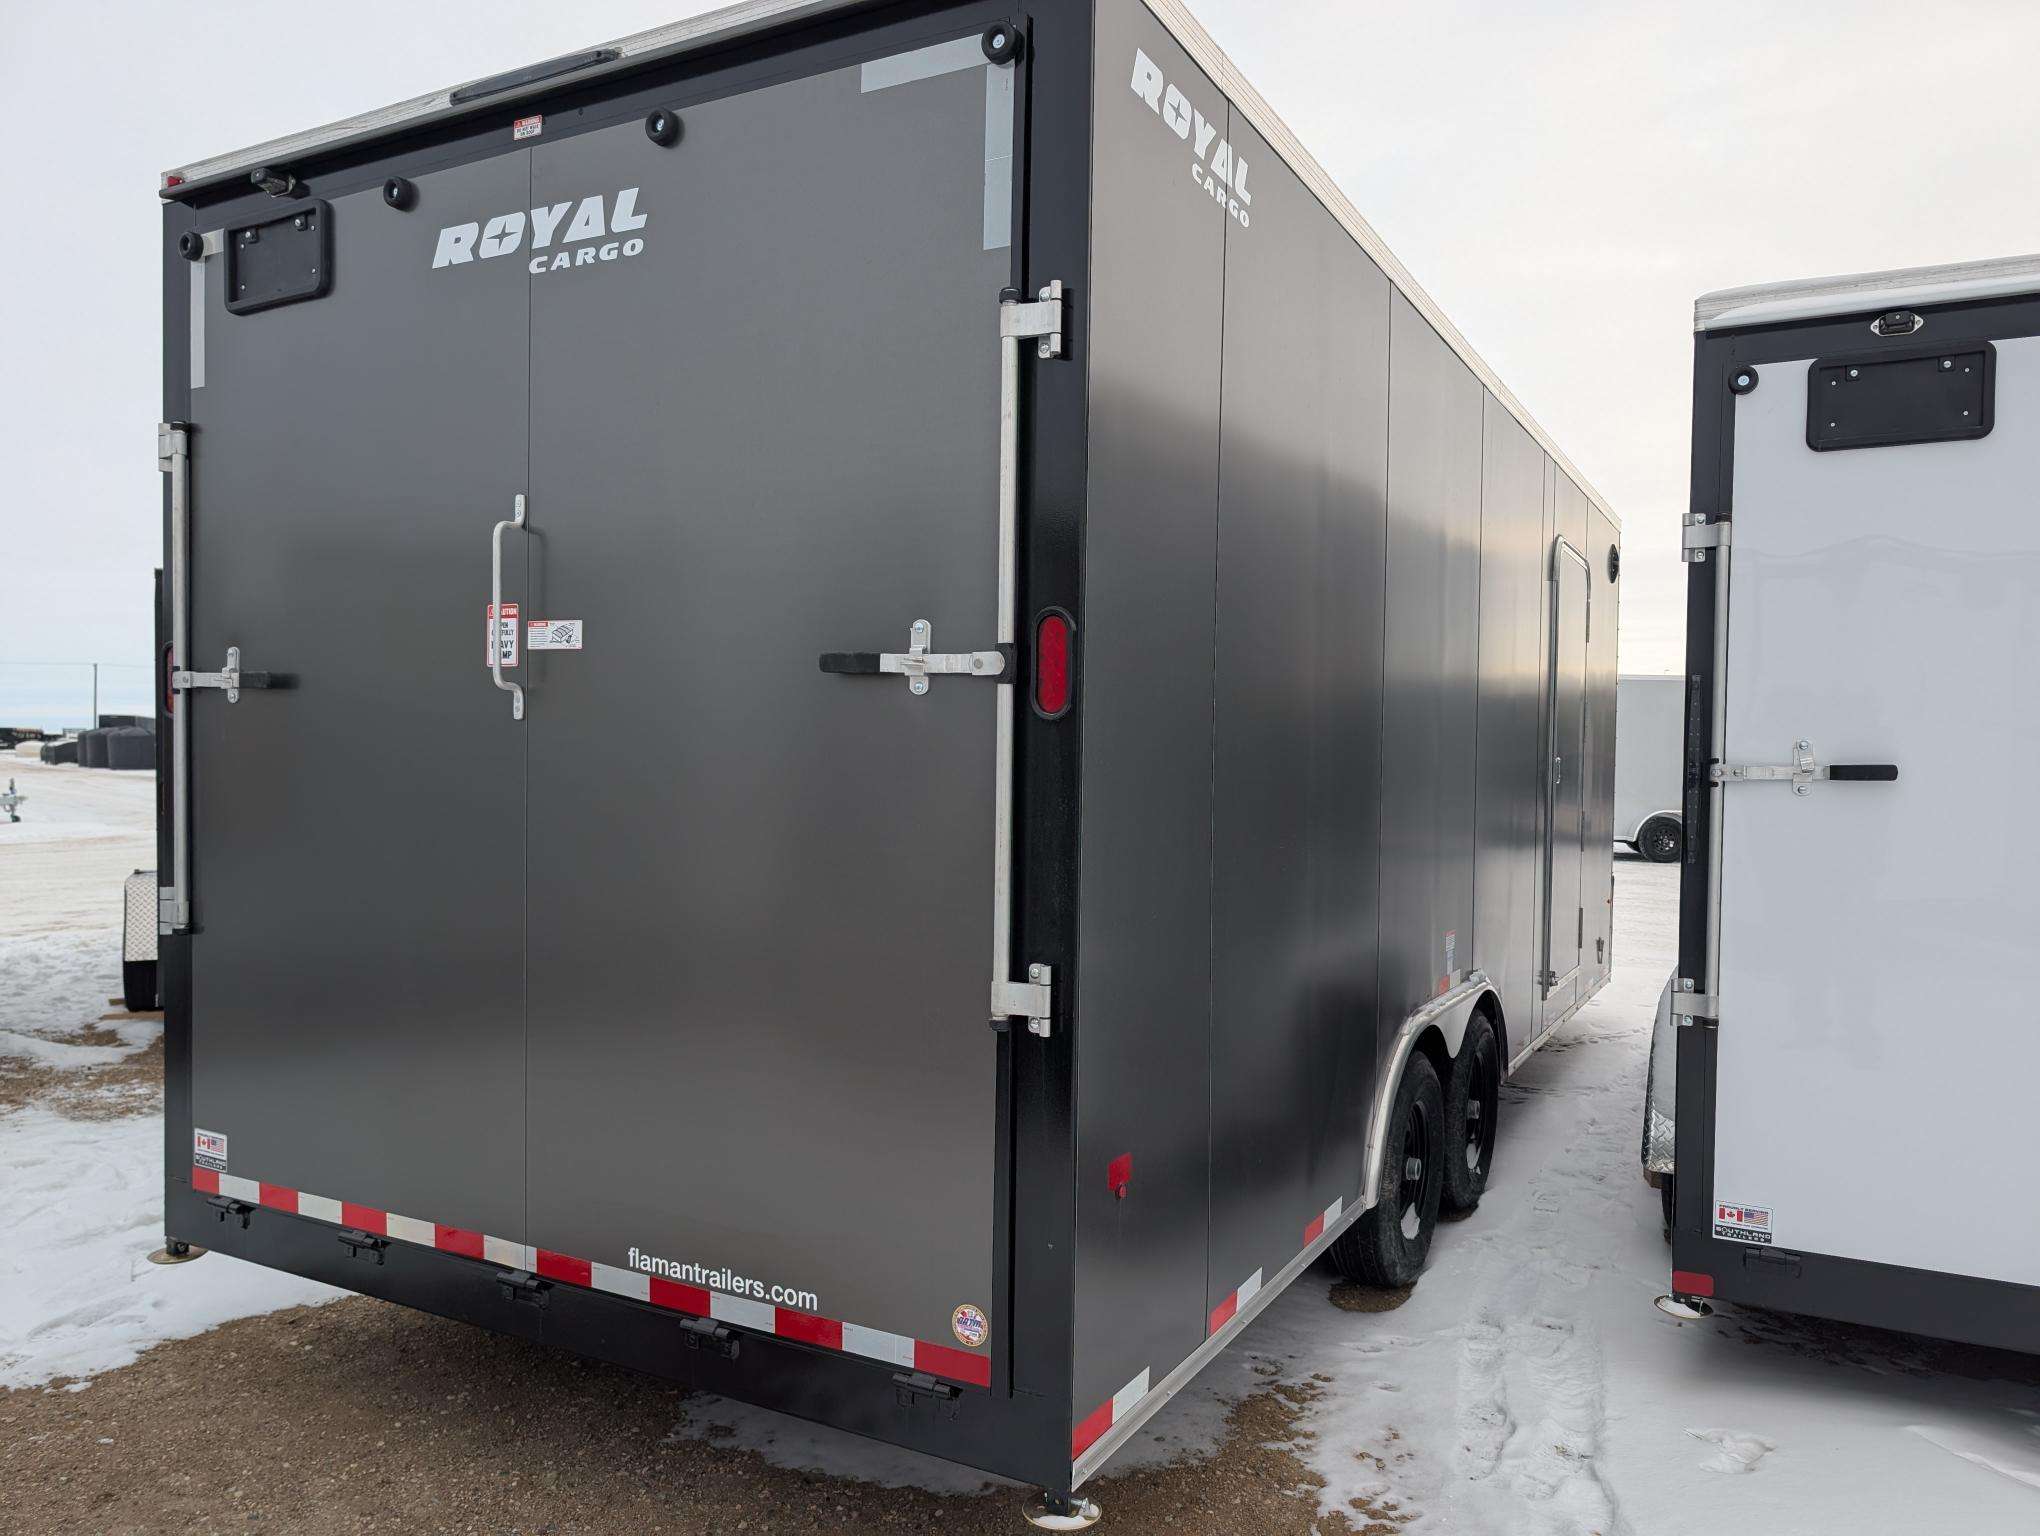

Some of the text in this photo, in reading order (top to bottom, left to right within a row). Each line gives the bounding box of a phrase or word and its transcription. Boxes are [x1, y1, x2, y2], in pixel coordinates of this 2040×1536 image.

[1131, 47, 1251, 206] ROYAL
[1191, 163, 1250, 227] CARGO
[432, 187, 648, 269] ROYAL
[528, 238, 644, 274] CARGO
[628, 1247, 818, 1311] flamantrailers.com
